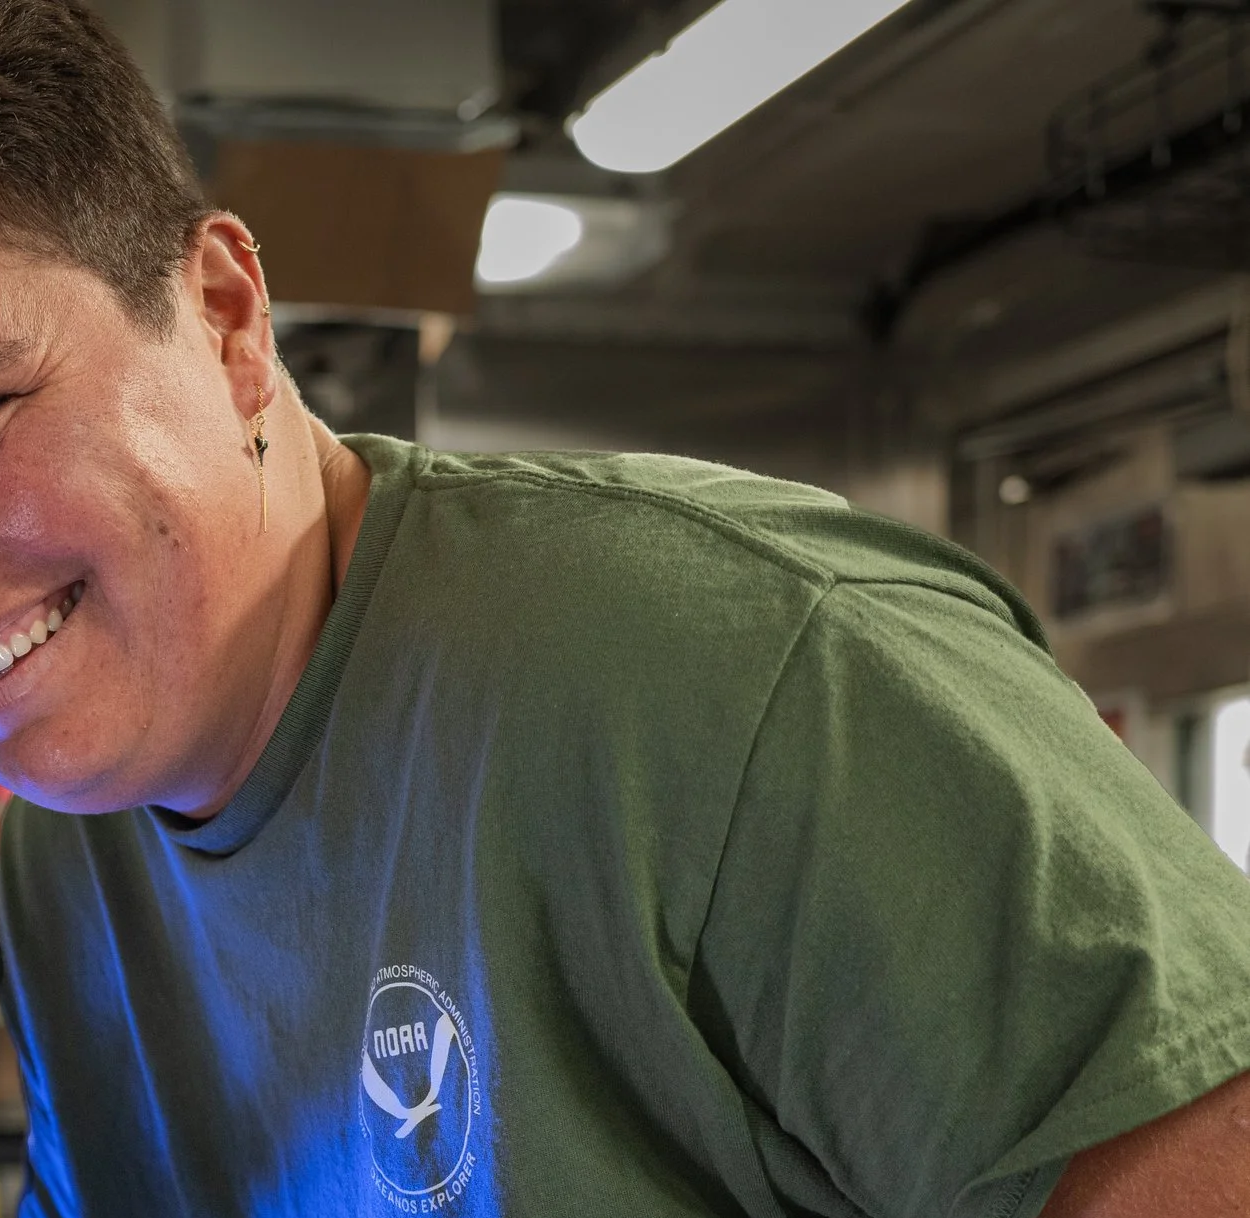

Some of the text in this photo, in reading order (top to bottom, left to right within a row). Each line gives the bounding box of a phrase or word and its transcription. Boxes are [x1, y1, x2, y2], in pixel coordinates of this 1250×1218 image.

[373, 1021, 429, 1059] NOAA
[376, 964, 482, 1116] ATMOSPHERIC ADMINISTRATION
[369, 1151, 476, 1215] OKEANOS EXPLORER
